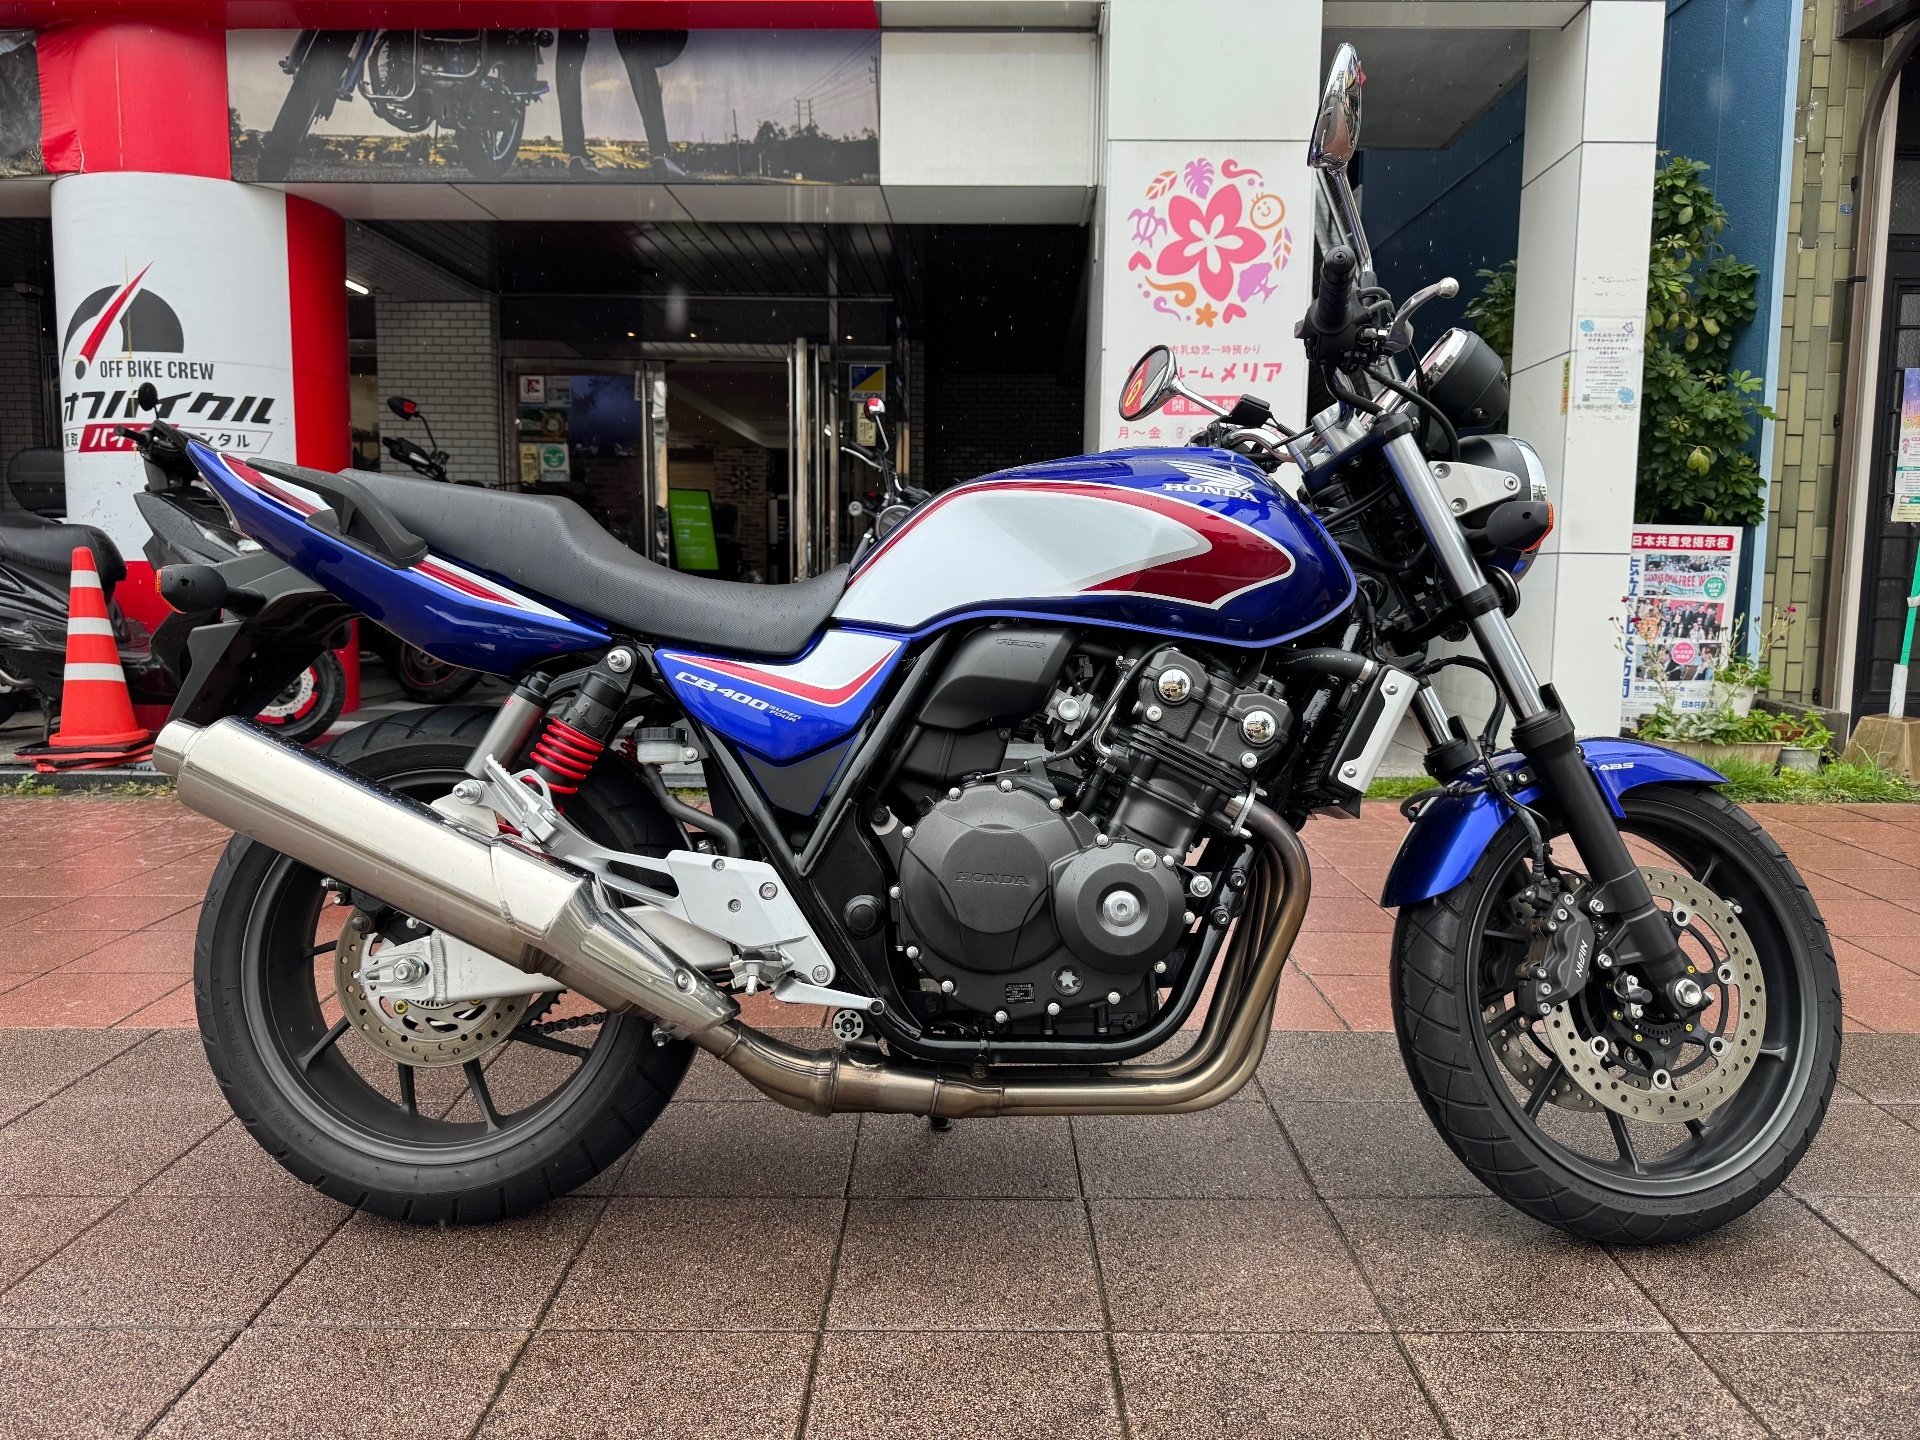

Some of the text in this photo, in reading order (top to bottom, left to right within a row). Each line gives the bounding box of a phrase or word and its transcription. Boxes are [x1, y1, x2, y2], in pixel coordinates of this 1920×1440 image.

[1149, 344, 1261, 355] 市乳幼児一時預かり
[100, 360, 214, 380] OFF BIKE CREW
[1220, 362, 1283, 383] メリア
[64, 388, 275, 425] オフバイクル
[1171, 399, 1236, 413] 開園間
[1163, 482, 1260, 503] HONDA
[1632, 535, 1729, 549] 日本共産党掲示板
[675, 671, 770, 712] CB400
[1599, 762, 1634, 771] ABS
[956, 871, 1031, 887] HONDA
